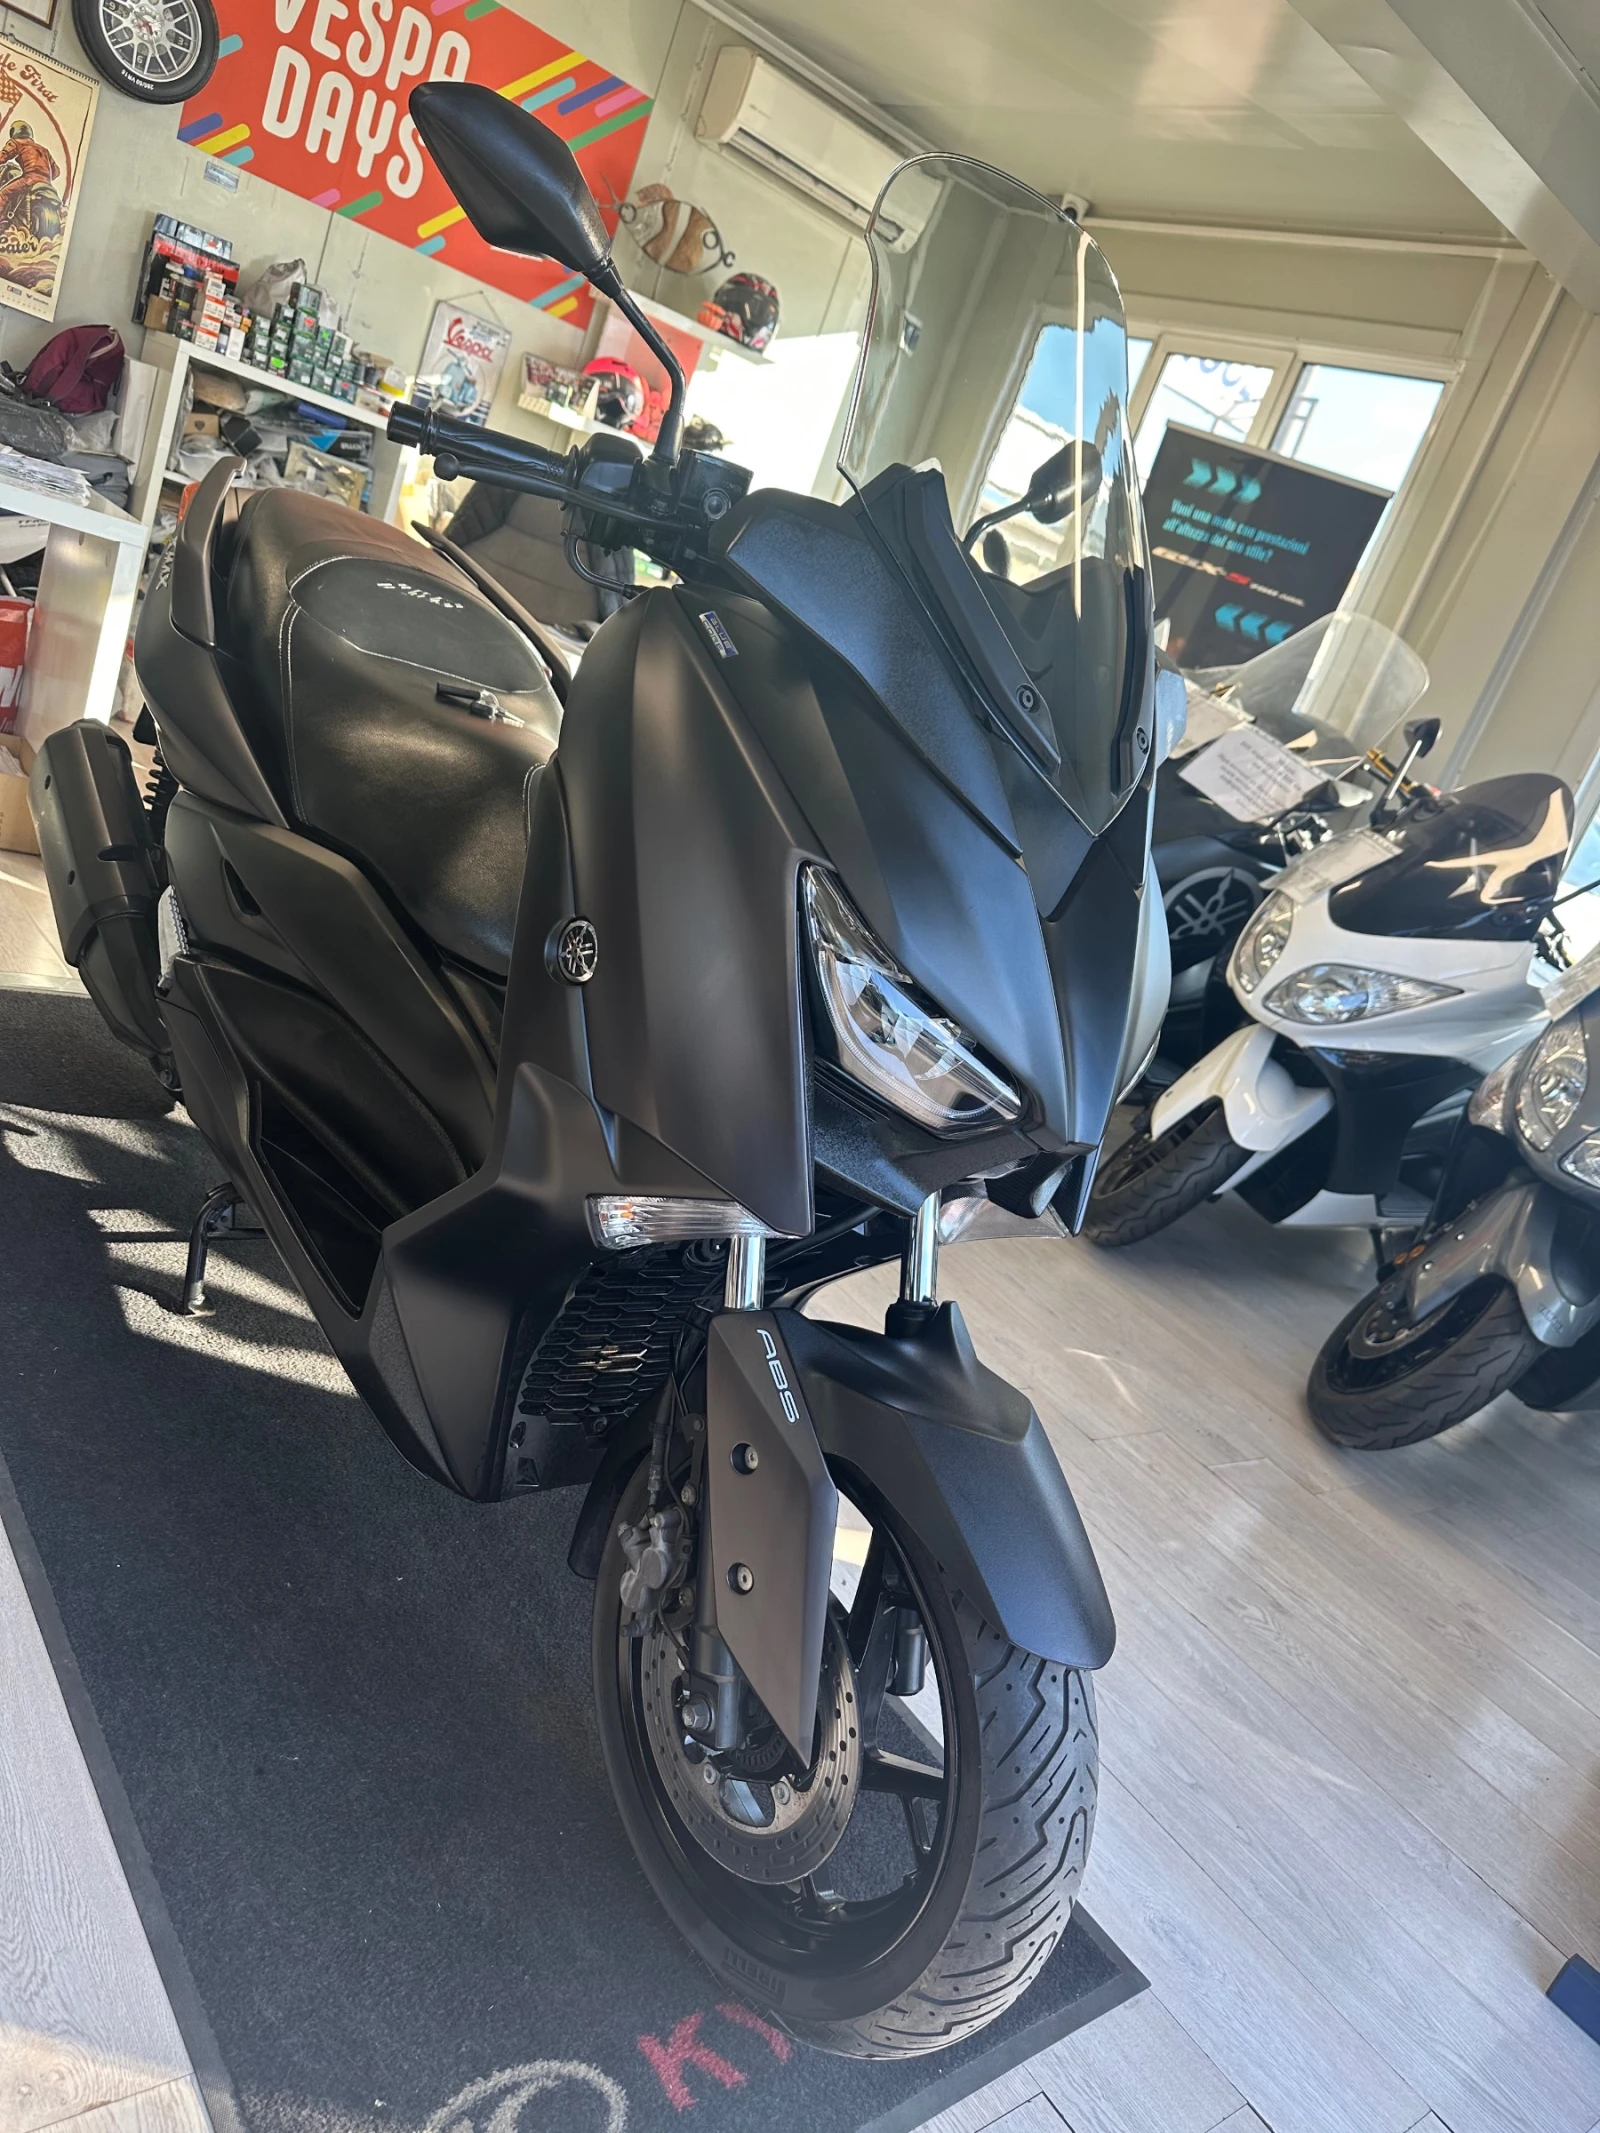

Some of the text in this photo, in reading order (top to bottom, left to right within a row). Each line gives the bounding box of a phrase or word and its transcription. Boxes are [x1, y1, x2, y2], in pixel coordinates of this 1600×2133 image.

[20, 64, 59, 103] First
[261, 45, 426, 199] DAYS
[443, 316, 495, 364] Vespa
[702, 620, 724, 651] CORE
[710, 617, 732, 649] BLUE
[756, 1328, 800, 1423] ABS
